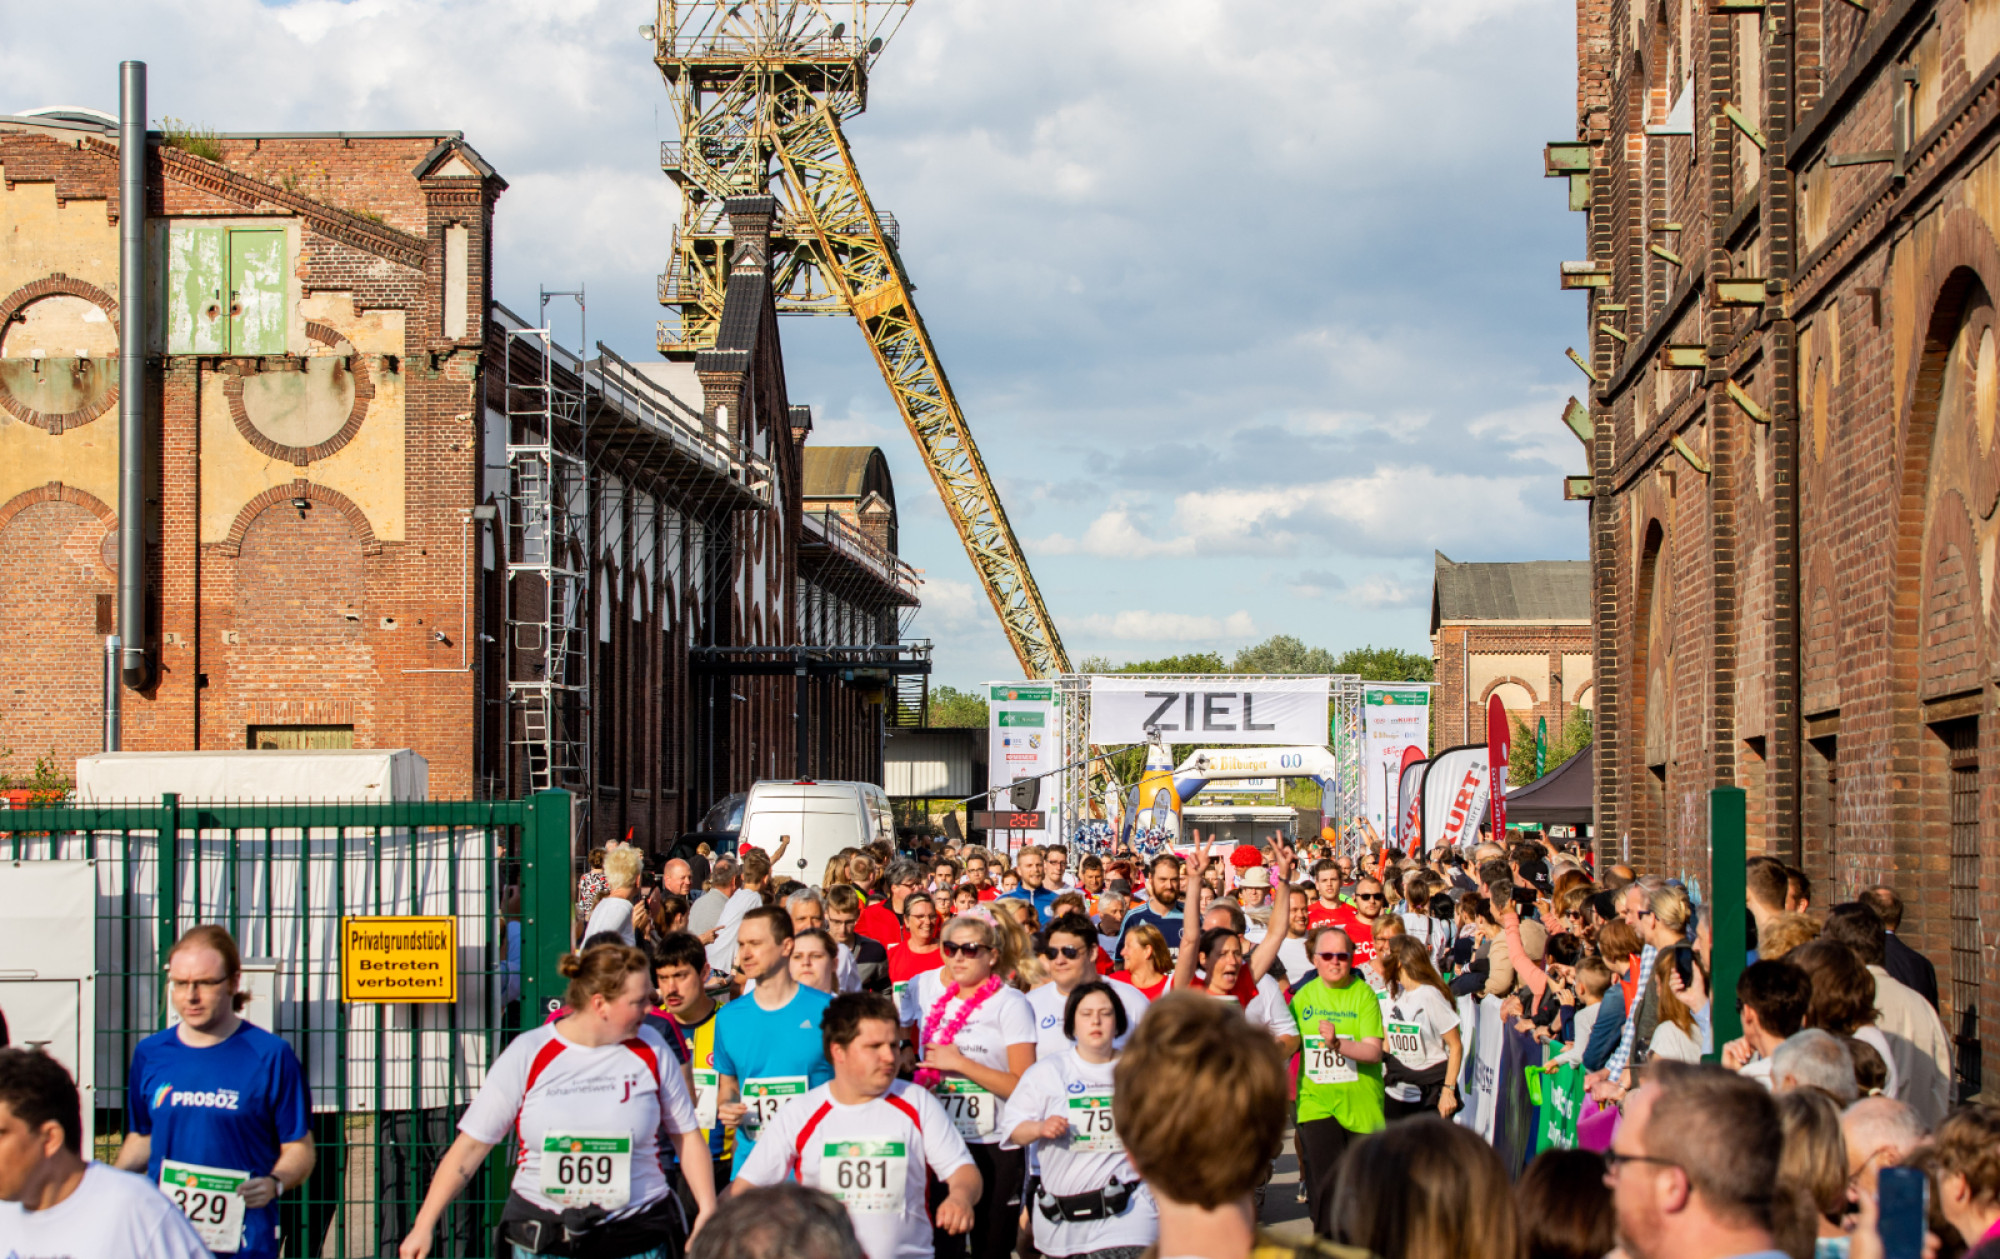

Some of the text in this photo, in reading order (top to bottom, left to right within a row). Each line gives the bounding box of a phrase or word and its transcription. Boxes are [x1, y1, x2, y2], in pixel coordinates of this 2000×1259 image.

[1142, 690, 1275, 731] ZIEL
[1219, 753, 1302, 772] Bitburger 0.0
[1010, 813, 1038, 827] 2:52
[352, 930, 447, 954] Privatgrundstück
[360, 960, 439, 970] Betreten
[357, 976, 443, 987] verboten!
[1390, 1034, 1418, 1051] 1000
[1312, 1050, 1346, 1068] 768
[171, 1091, 239, 1110] PROSOZ
[752, 1097, 792, 1123] 13
[940, 1095, 980, 1119] 778
[1082, 1109, 1113, 1132] 75
[558, 1155, 612, 1185] 669
[837, 1160, 887, 1189] 681
[174, 1189, 227, 1224] 329
